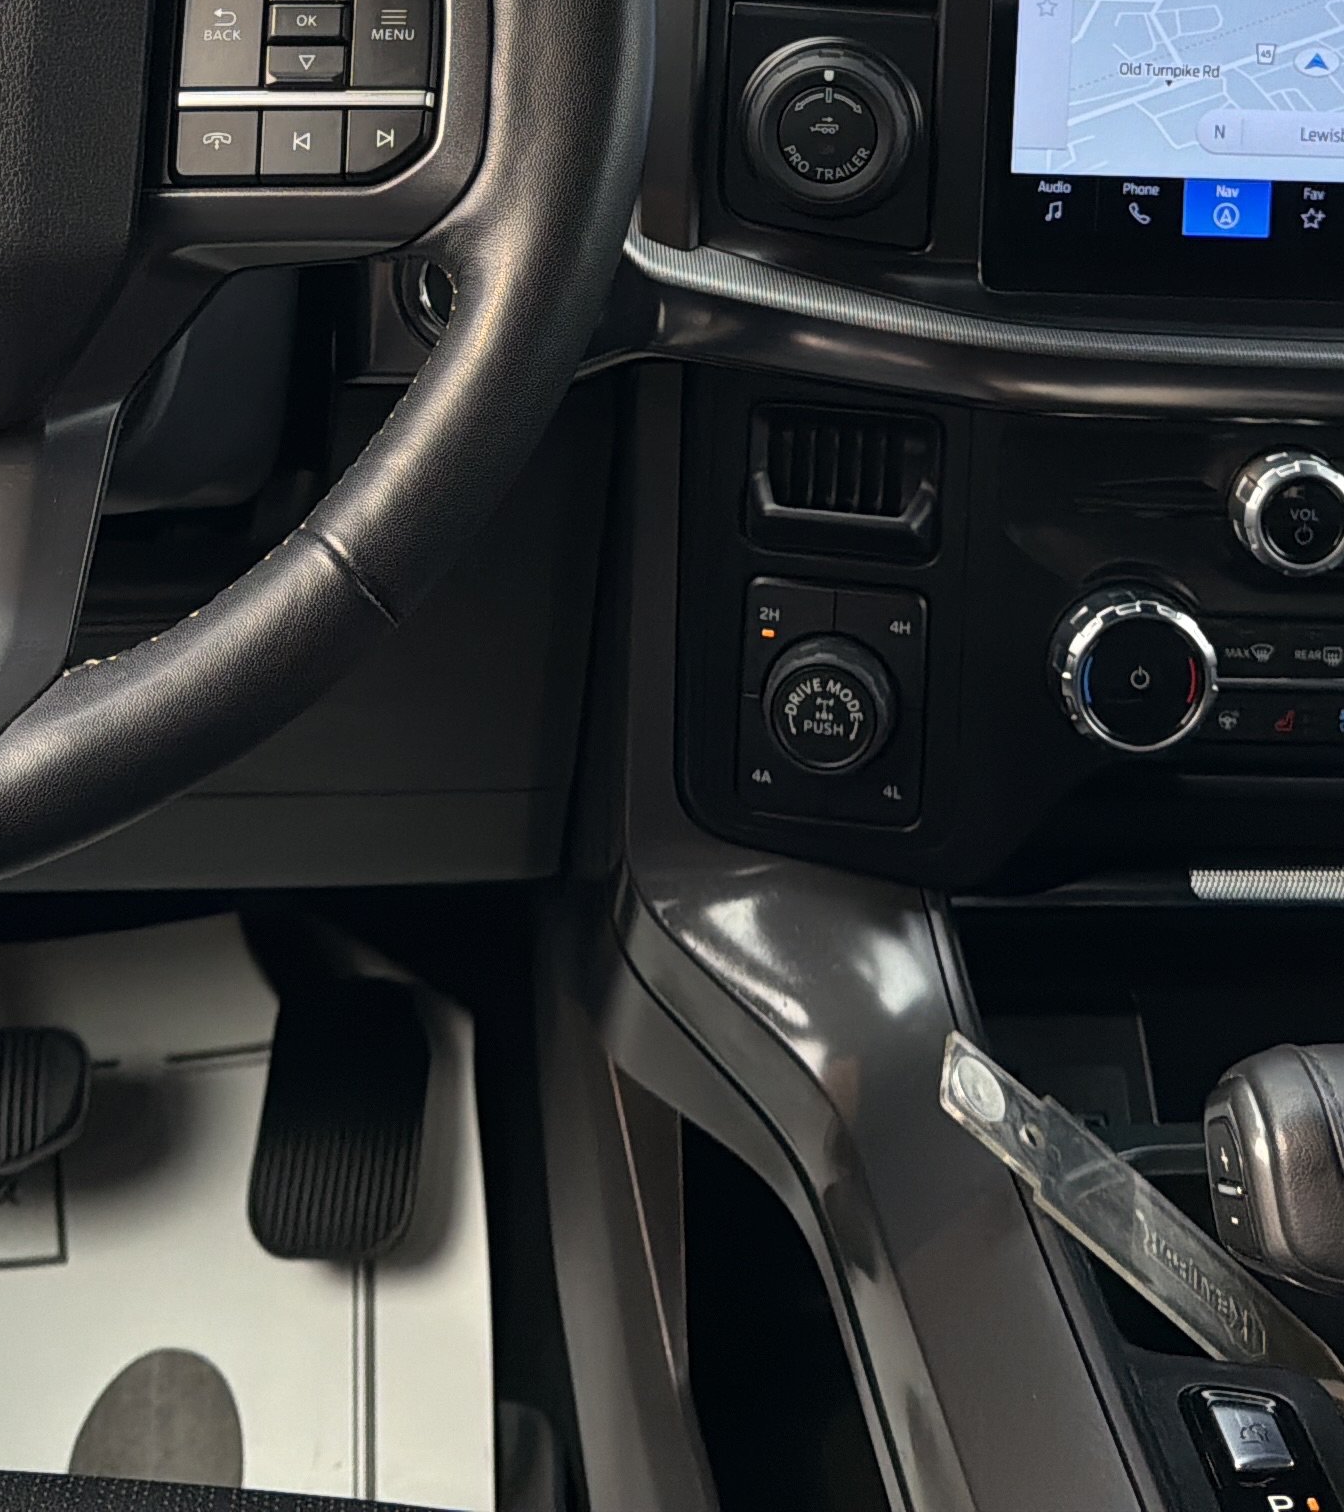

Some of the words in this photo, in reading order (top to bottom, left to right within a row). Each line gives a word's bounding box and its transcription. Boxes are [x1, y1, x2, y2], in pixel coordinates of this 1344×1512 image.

[296, 14, 318, 28] OK
[203, 29, 242, 42] BACK
[370, 28, 416, 41] MENU
[1260, 49, 1272, 59] 45
[1119, 62, 1142, 76] Old
[1144, 64, 1200, 80] Turnpike
[1202, 65, 1221, 78] Rd
[1214, 124, 1226, 138] N
[783, 144, 810, 173] PRO
[814, 146, 872, 181] TRAILER
[1037, 180, 1072, 194] Audio
[1122, 182, 1160, 196] Phone
[1215, 184, 1240, 199] Nav
[1303, 187, 1326, 201] Fav
[1289, 508, 1319, 523] VOL
[759, 606, 780, 622] 2H
[889, 621, 911, 635] 4H
[1294, 648, 1321, 660] REAR
[784, 677, 823, 716] DRIVE
[826, 679, 863, 722] MODE
[803, 719, 844, 737] PUSH
[751, 768, 773, 785] 4A
[882, 784, 903, 800] 4L
[1267, 1495, 1294, 1512] P
